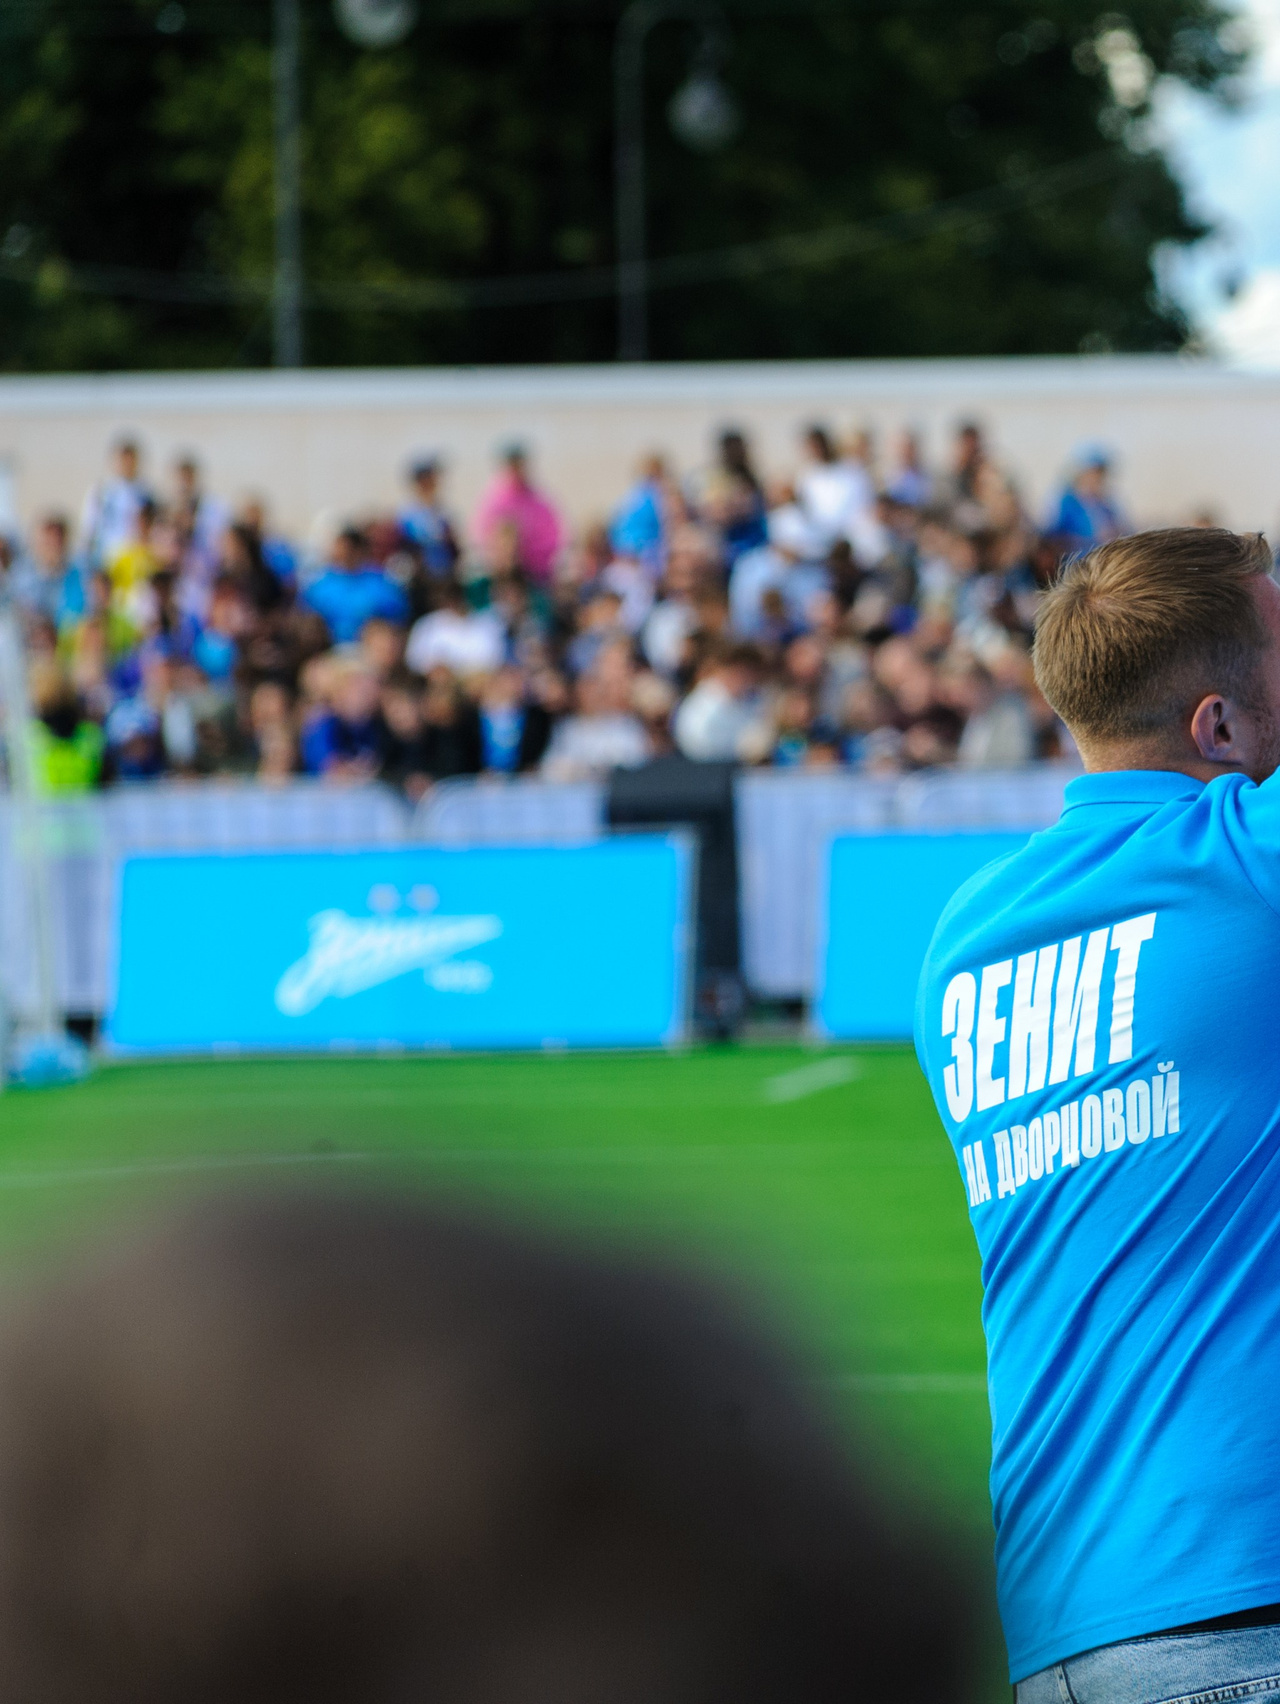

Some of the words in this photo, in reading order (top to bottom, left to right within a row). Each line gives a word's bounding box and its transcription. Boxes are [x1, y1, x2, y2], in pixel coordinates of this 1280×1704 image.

[942, 912, 1157, 1123] ЗЕНИТ
[963, 1140, 992, 1207] НА
[993, 1061, 1180, 1199] ДВОРЦОВОЙ
